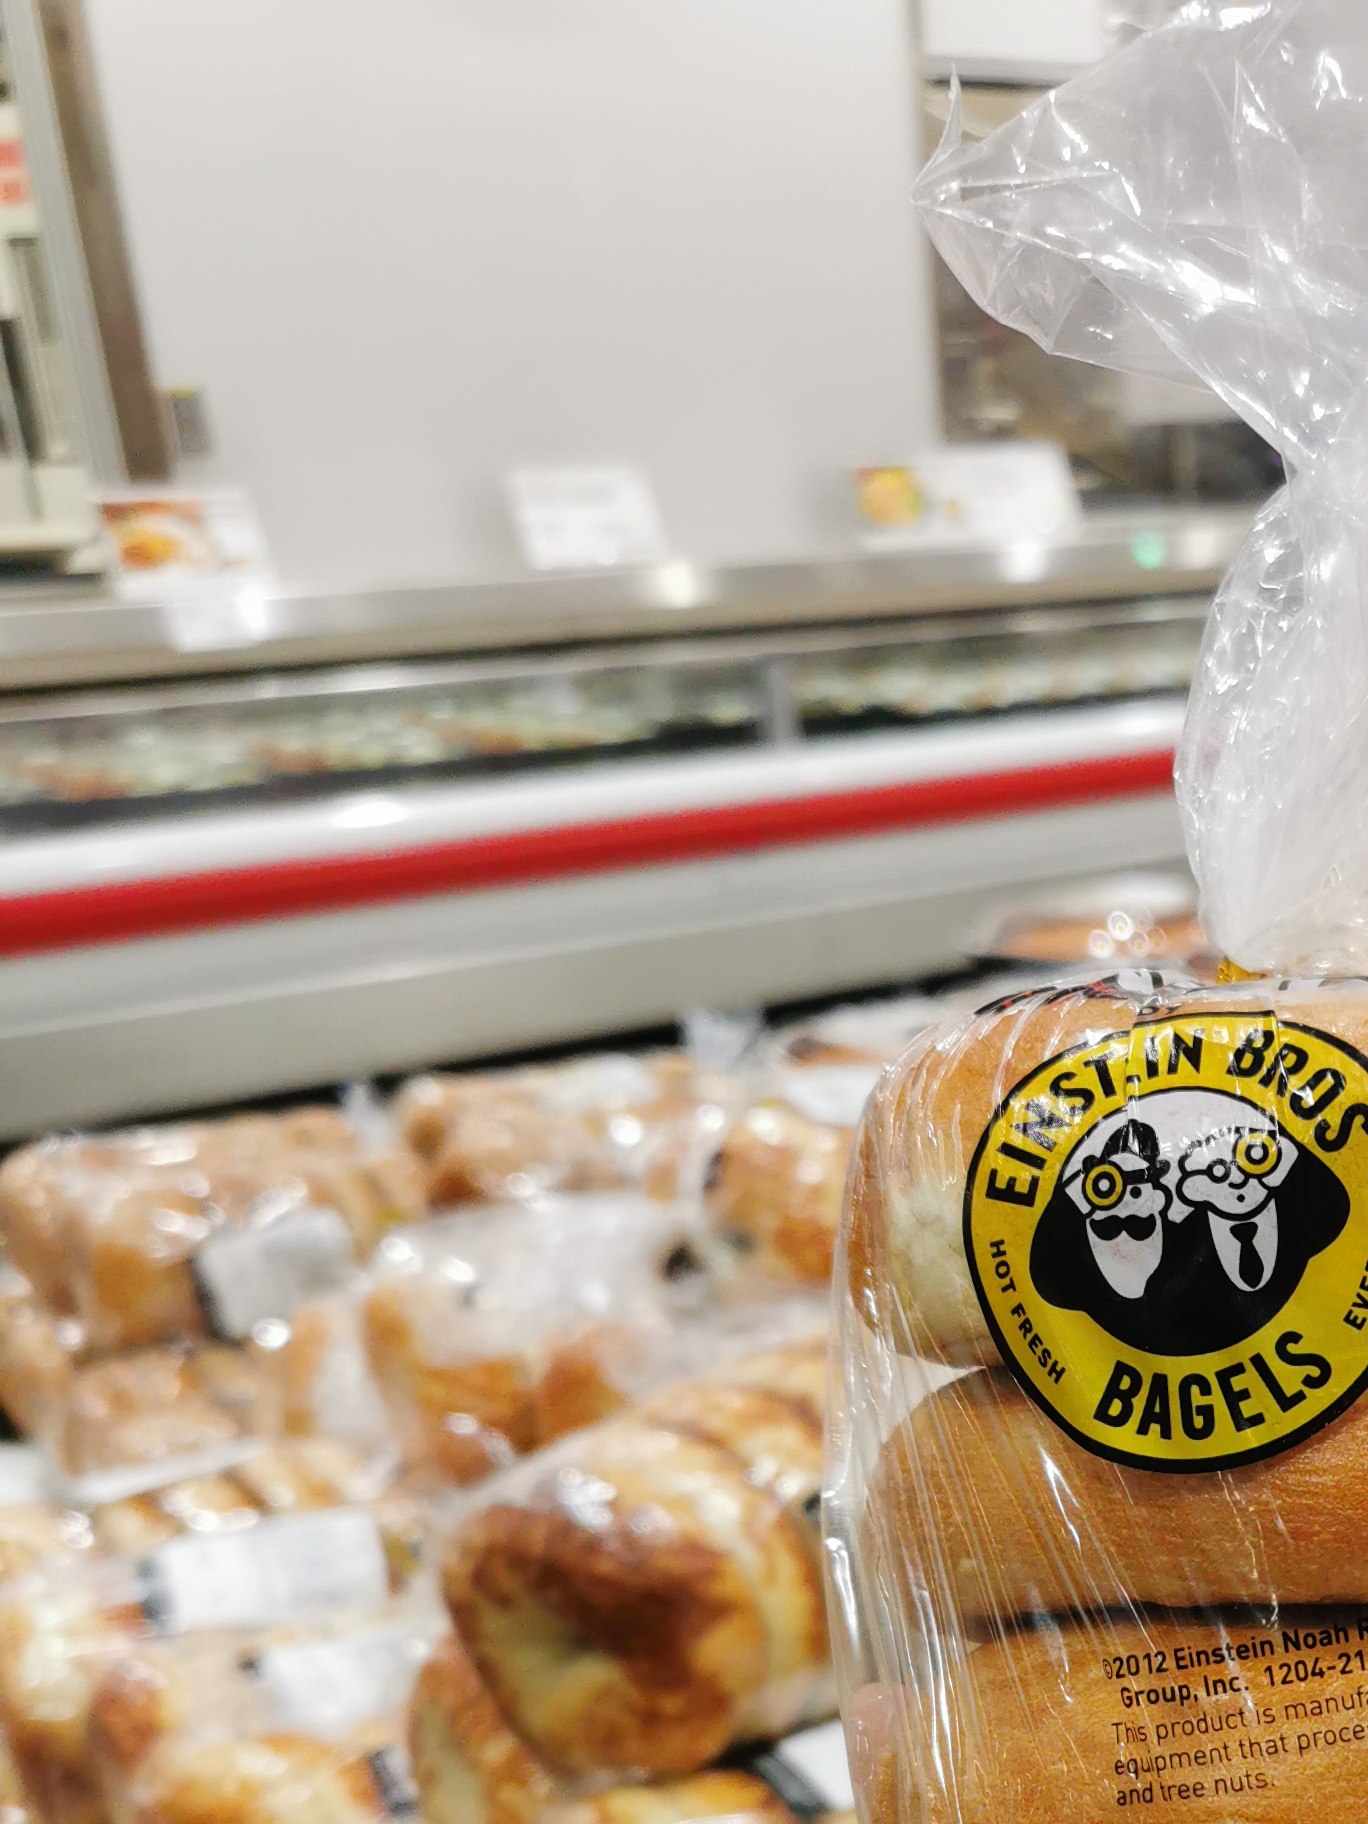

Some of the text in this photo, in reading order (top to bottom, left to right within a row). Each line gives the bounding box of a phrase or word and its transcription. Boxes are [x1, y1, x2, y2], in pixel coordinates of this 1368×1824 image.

[988, 1240, 1066, 1385] HOT FRESH
[1093, 1331, 1332, 1441] BAGELS
[1173, 1635, 1276, 1670] Einstein
[1282, 1624, 1350, 1654] Noah
[1120, 1683, 1199, 1709] Group,
[1203, 1674, 1249, 1697] Inc.
[1112, 1721, 1148, 1745] This
[1155, 1710, 1246, 1747] product
[1256, 1704, 1277, 1726] is
[1114, 1746, 1232, 1780] equipment
[1238, 1733, 1288, 1760] that
[1116, 1769, 1276, 1806] and tree nuts.
